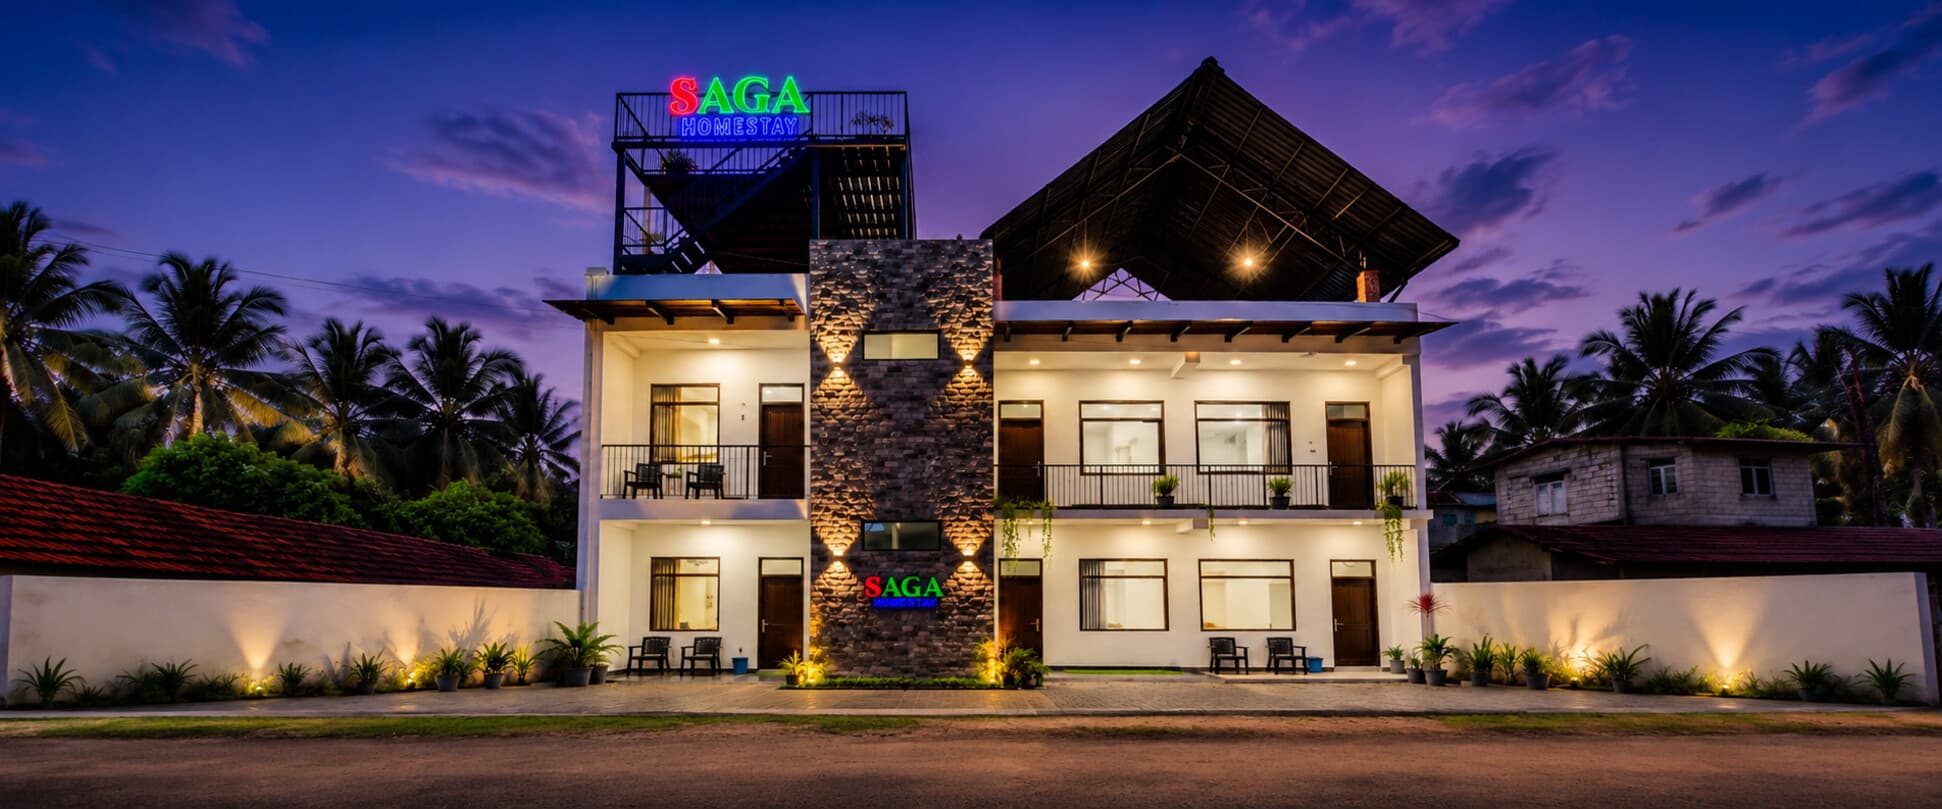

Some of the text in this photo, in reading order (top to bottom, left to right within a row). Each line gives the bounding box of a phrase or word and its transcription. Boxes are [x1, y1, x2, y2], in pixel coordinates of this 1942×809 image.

[670, 76, 810, 115] SAGA
[681, 117, 798, 136] HOMESTAY
[865, 576, 944, 597] SAGA
